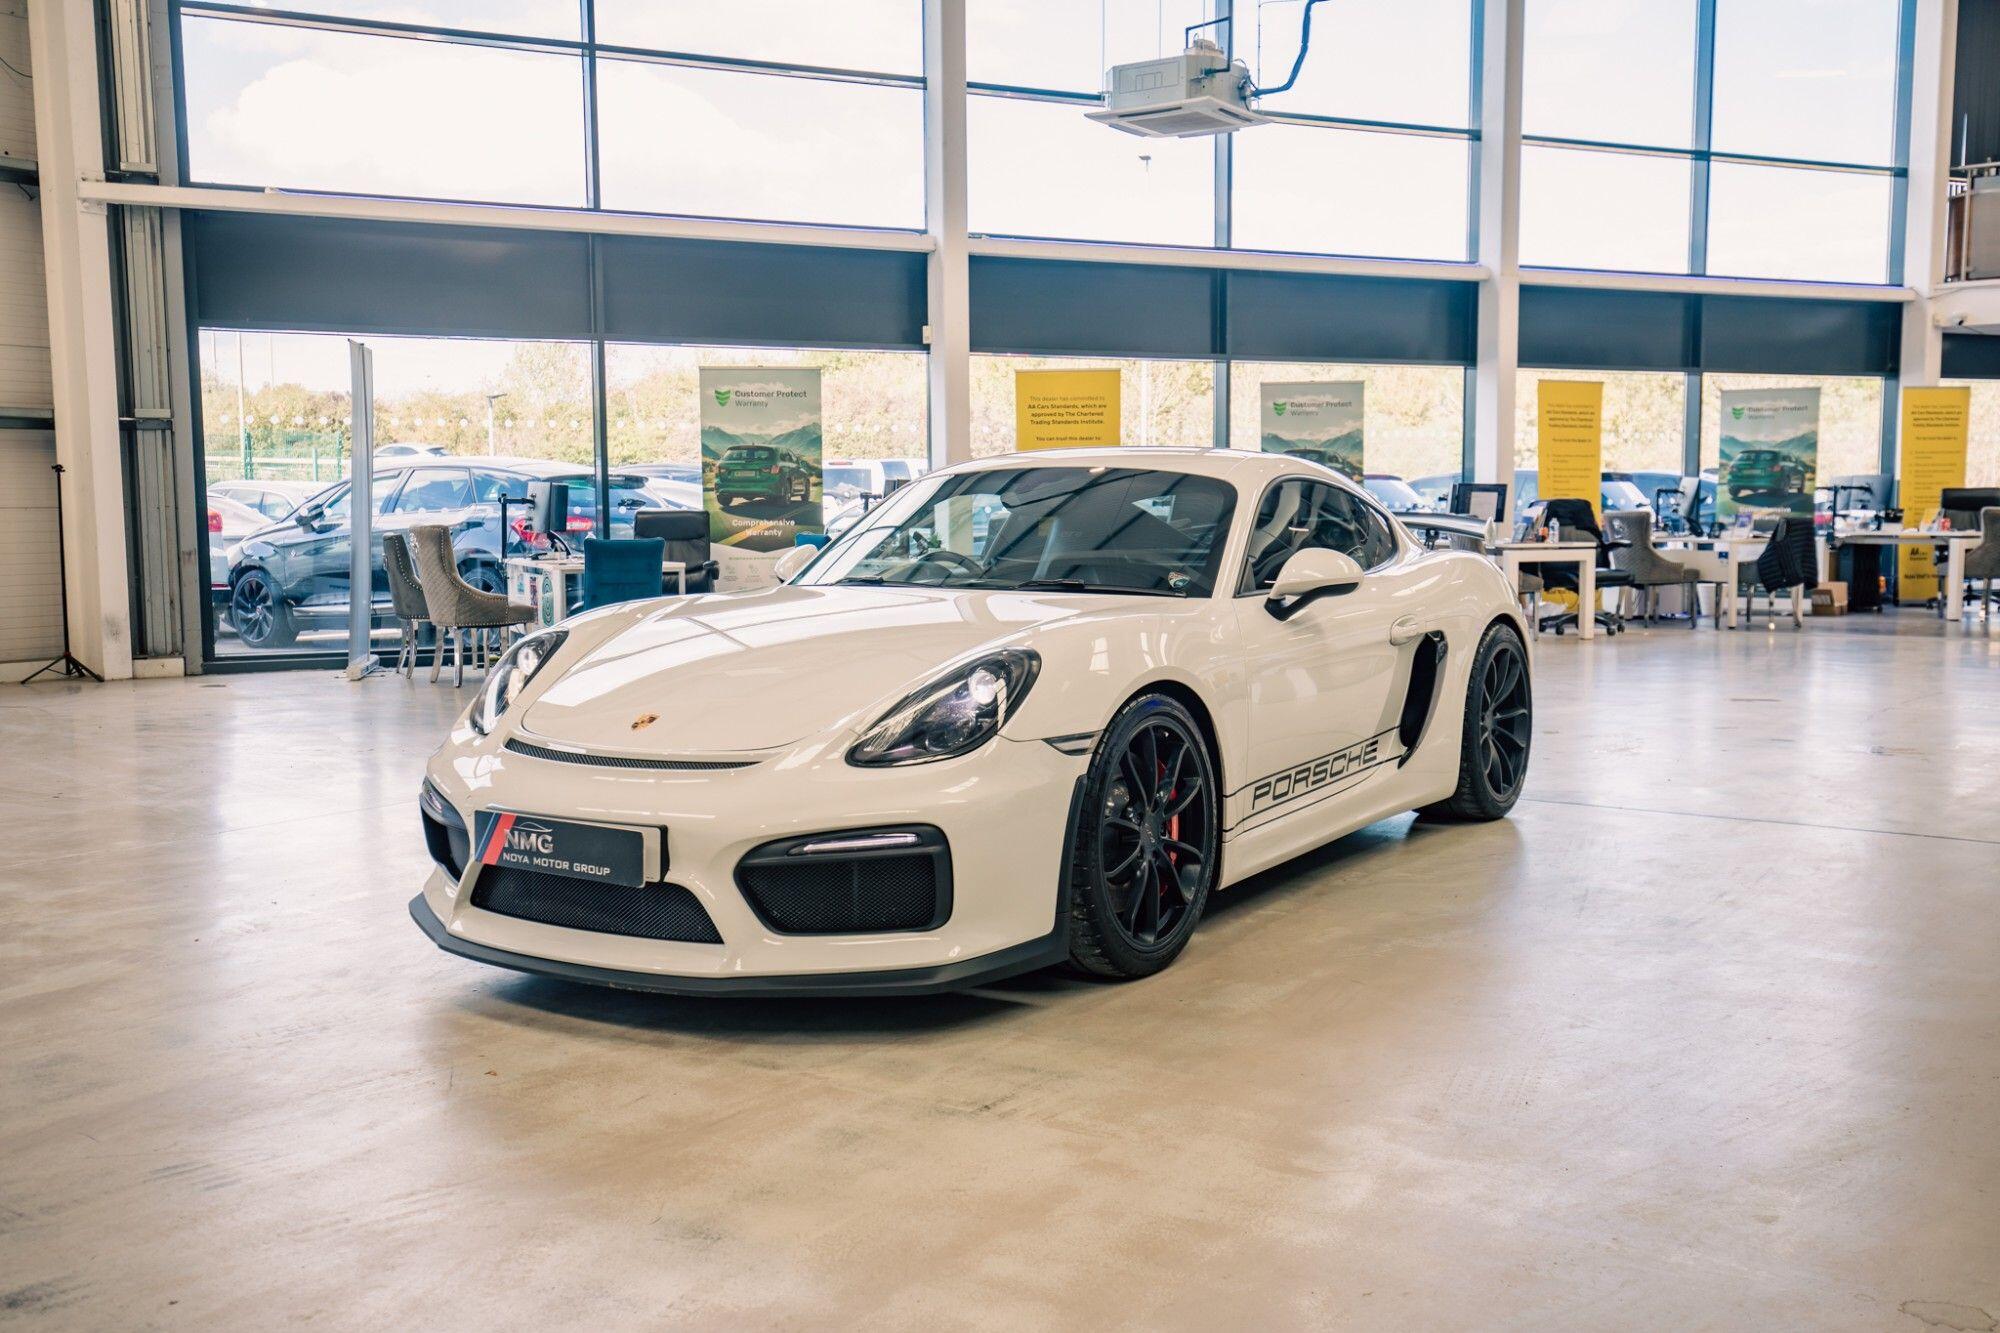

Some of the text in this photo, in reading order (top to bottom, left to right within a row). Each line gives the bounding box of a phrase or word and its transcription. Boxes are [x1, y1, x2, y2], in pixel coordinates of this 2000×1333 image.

[735, 390, 807, 398] Customer Protect
[735, 400, 768, 408] Warranty
[732, 518, 795, 528] Comprehensive
[1252, 739, 1379, 810] PORSCHE
[504, 829, 554, 854] NMG
[533, 857, 569, 870] MOTOR
[573, 863, 611, 876] GROUP
